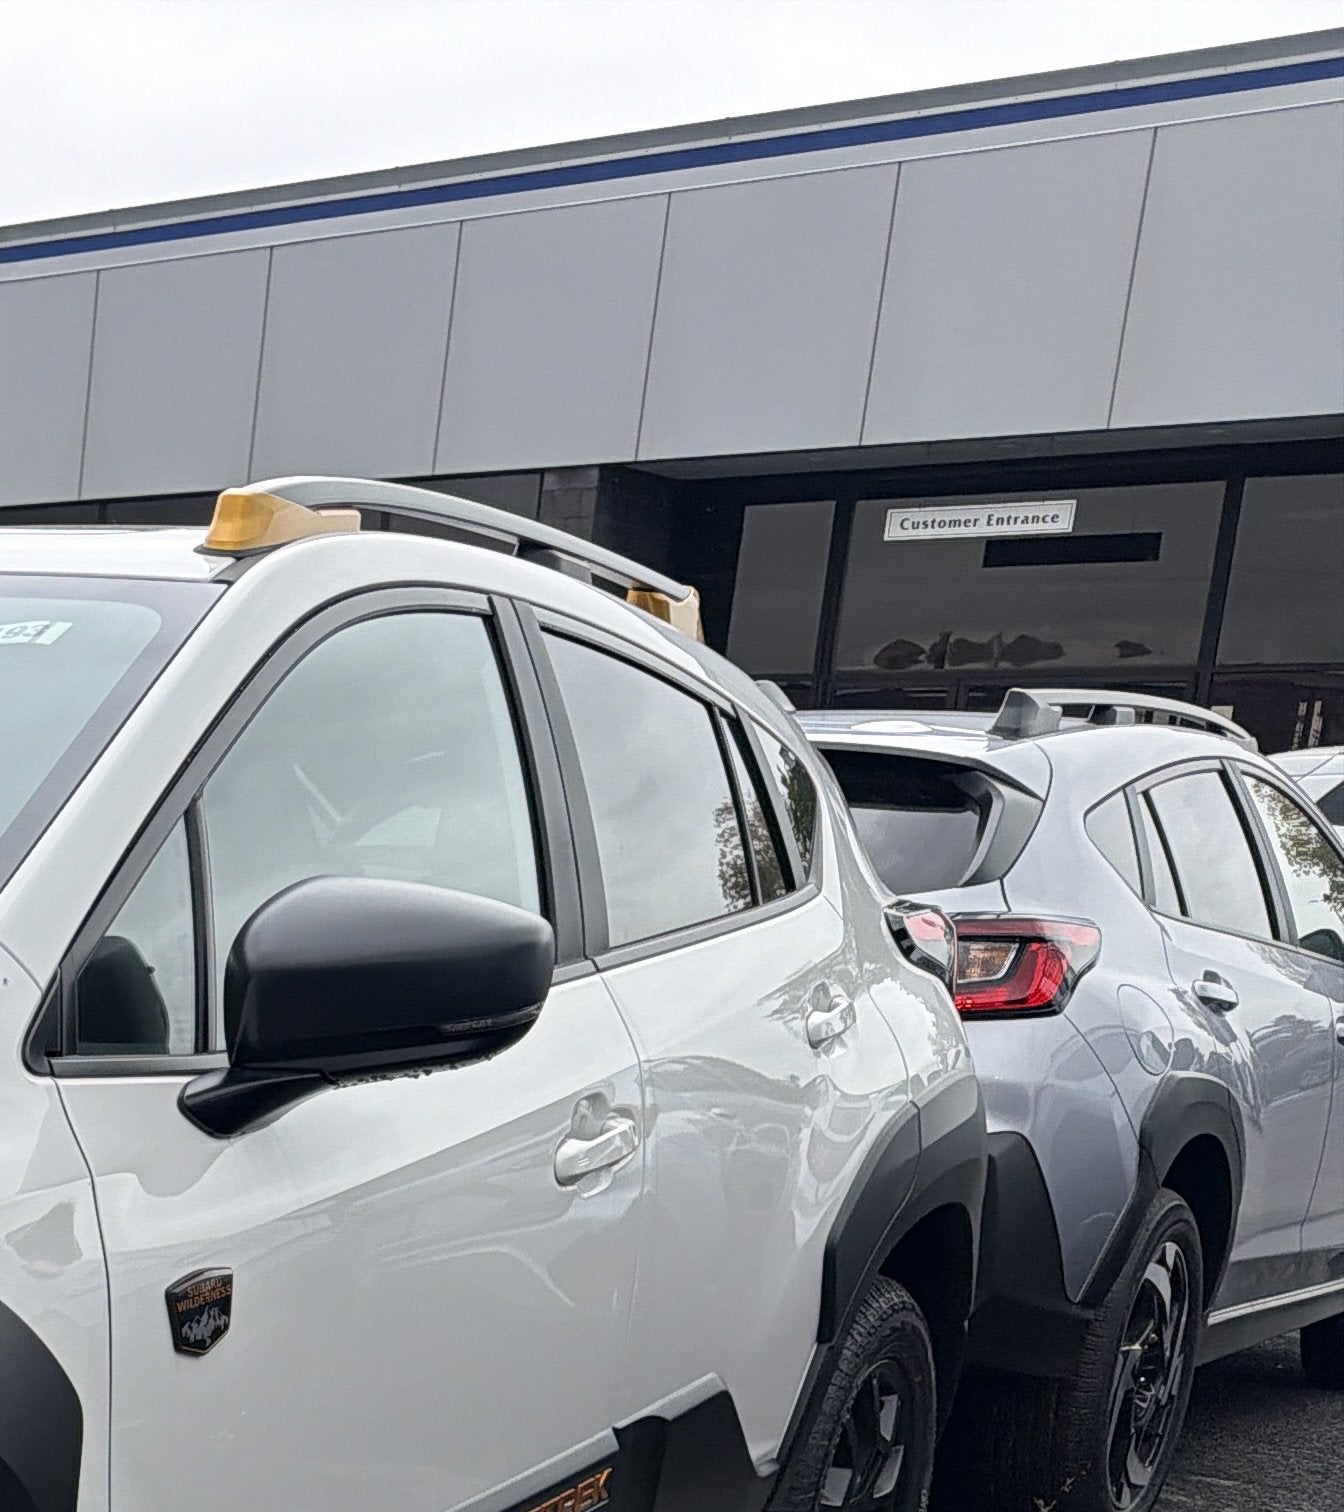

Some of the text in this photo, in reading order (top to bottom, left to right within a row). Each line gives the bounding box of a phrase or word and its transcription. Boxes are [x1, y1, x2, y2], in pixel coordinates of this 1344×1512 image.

[899, 513, 1060, 531] Customer Entrance
[187, 1277, 222, 1298] SUBARU
[175, 1284, 232, 1313] WILDERNESS
